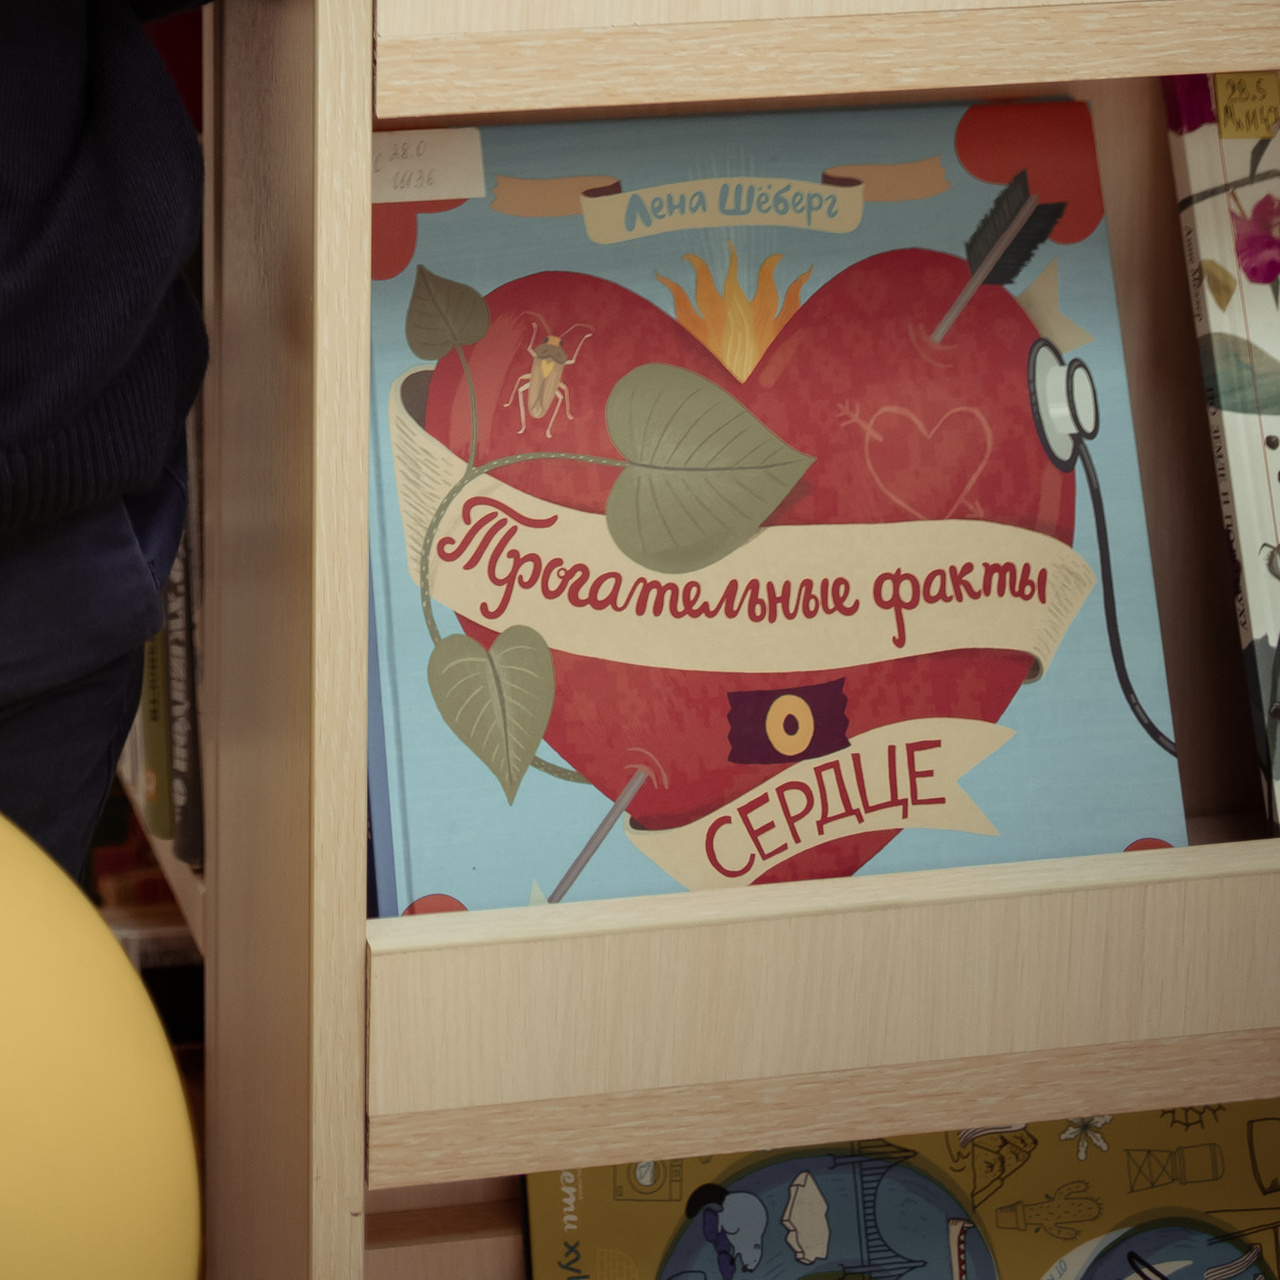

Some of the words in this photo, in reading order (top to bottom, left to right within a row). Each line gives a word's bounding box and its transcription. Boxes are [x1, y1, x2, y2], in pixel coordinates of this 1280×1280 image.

[1225, 77, 1267, 103] 28.5
[624, 189, 709, 231] Лена
[718, 182, 840, 222] Шёберг
[1208, 424, 1227, 483] ЗЕМЛЕ
[436, 495, 860, 620] Трогательные
[872, 565, 1049, 647] факты
[705, 739, 948, 880] СЕРДЦЕ
